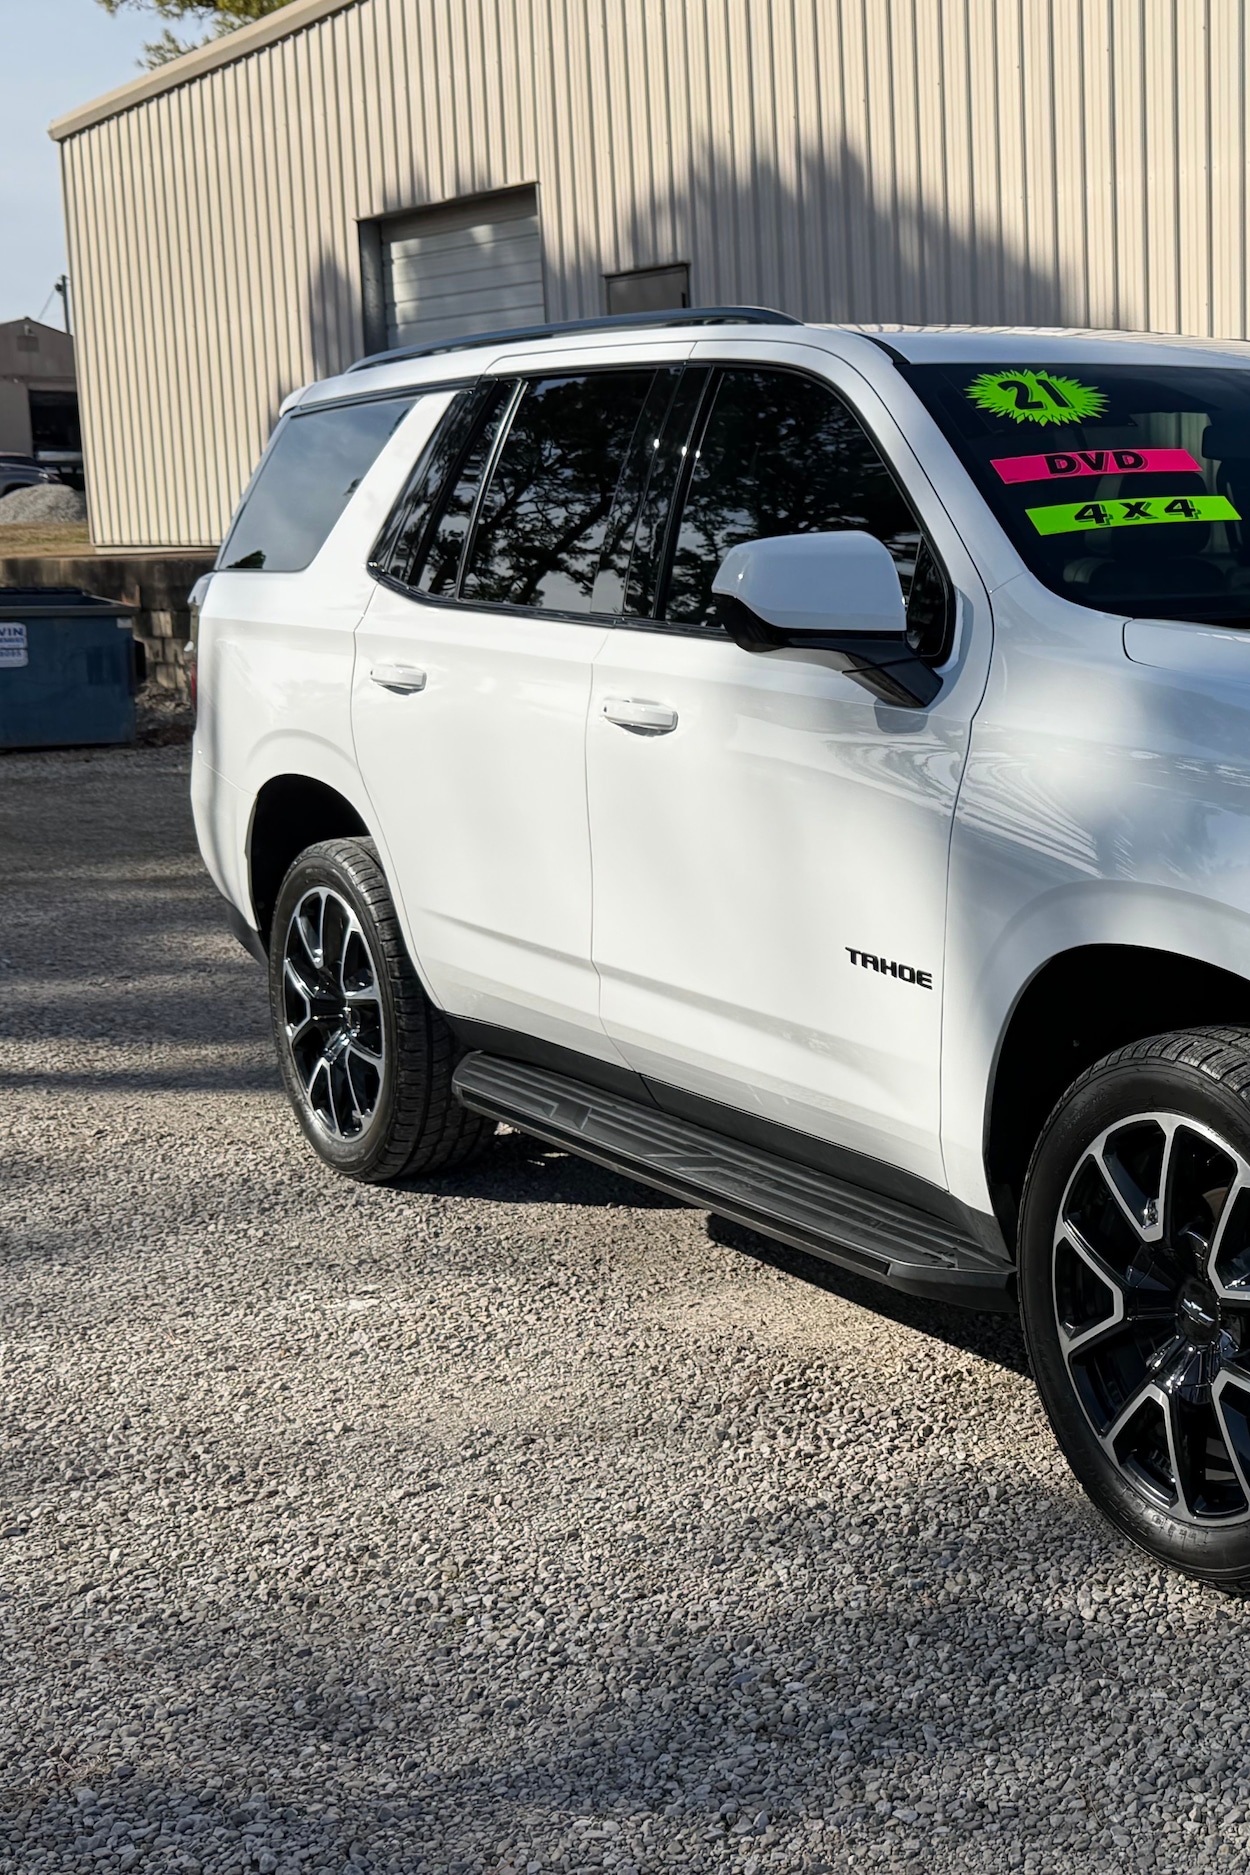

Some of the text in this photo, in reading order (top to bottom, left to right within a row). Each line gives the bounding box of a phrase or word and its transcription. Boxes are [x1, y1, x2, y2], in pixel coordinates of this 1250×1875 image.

[997, 379, 1074, 410] 21
[1044, 451, 1148, 476] DVD
[845, 946, 932, 990] TAHOE
